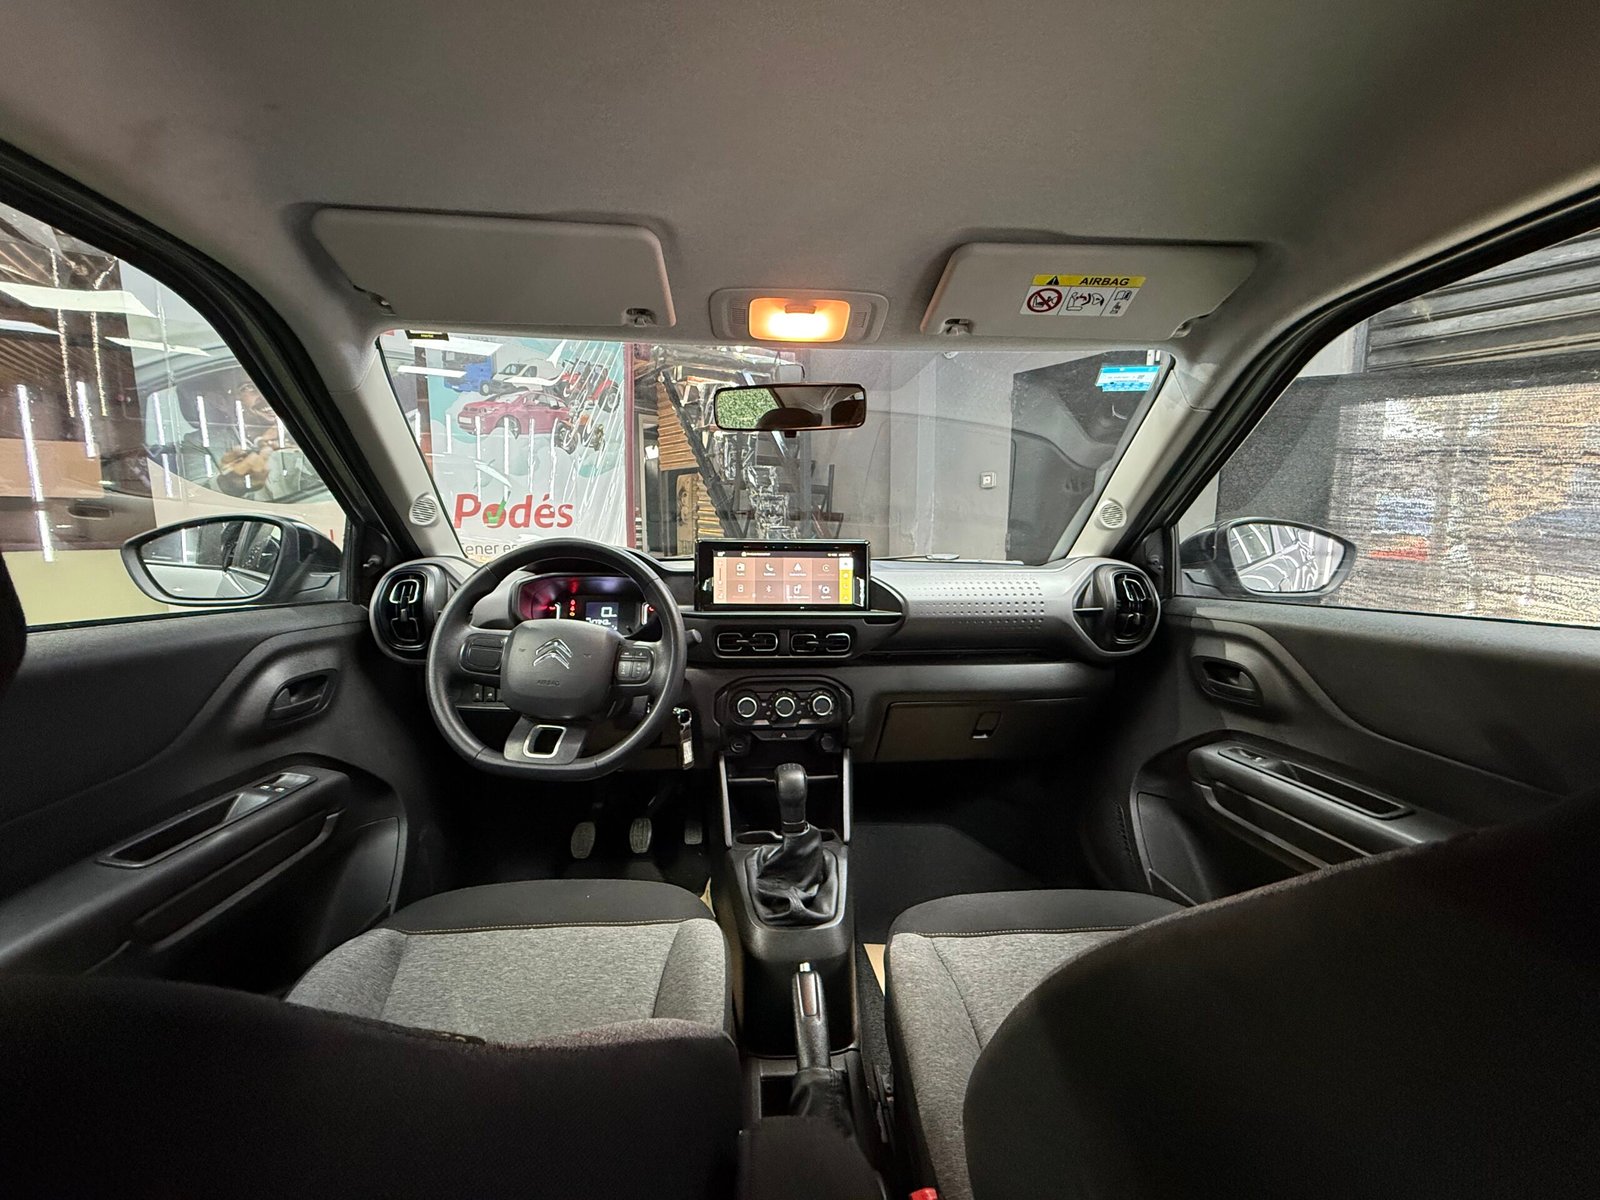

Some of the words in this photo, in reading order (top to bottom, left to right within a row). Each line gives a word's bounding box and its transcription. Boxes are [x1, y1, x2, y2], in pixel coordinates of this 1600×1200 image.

[1079, 277, 1131, 286] AIRBAG
[454, 491, 574, 529] Podés
[462, 543, 499, 555] ener
